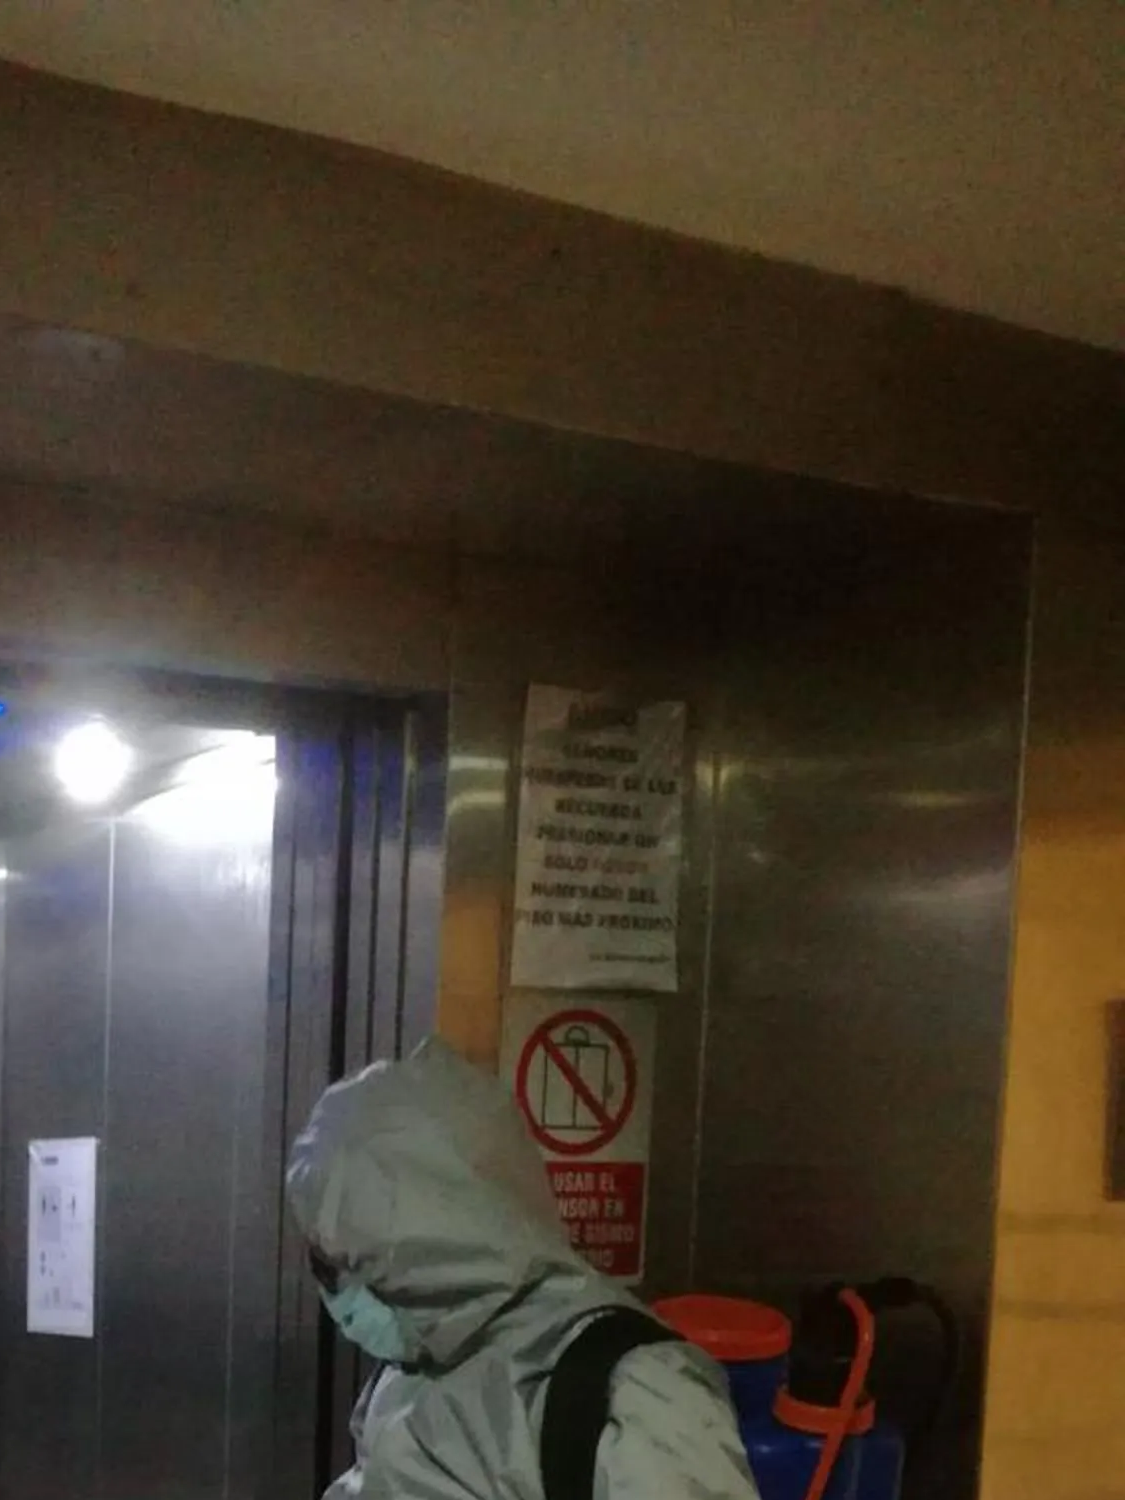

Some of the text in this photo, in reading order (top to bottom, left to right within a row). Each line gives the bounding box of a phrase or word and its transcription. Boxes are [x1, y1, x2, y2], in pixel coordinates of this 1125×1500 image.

[544, 855, 588, 871] SOLO
[554, 1171, 615, 1192] USAR EL
[557, 1196, 624, 1218] NSOR EN
